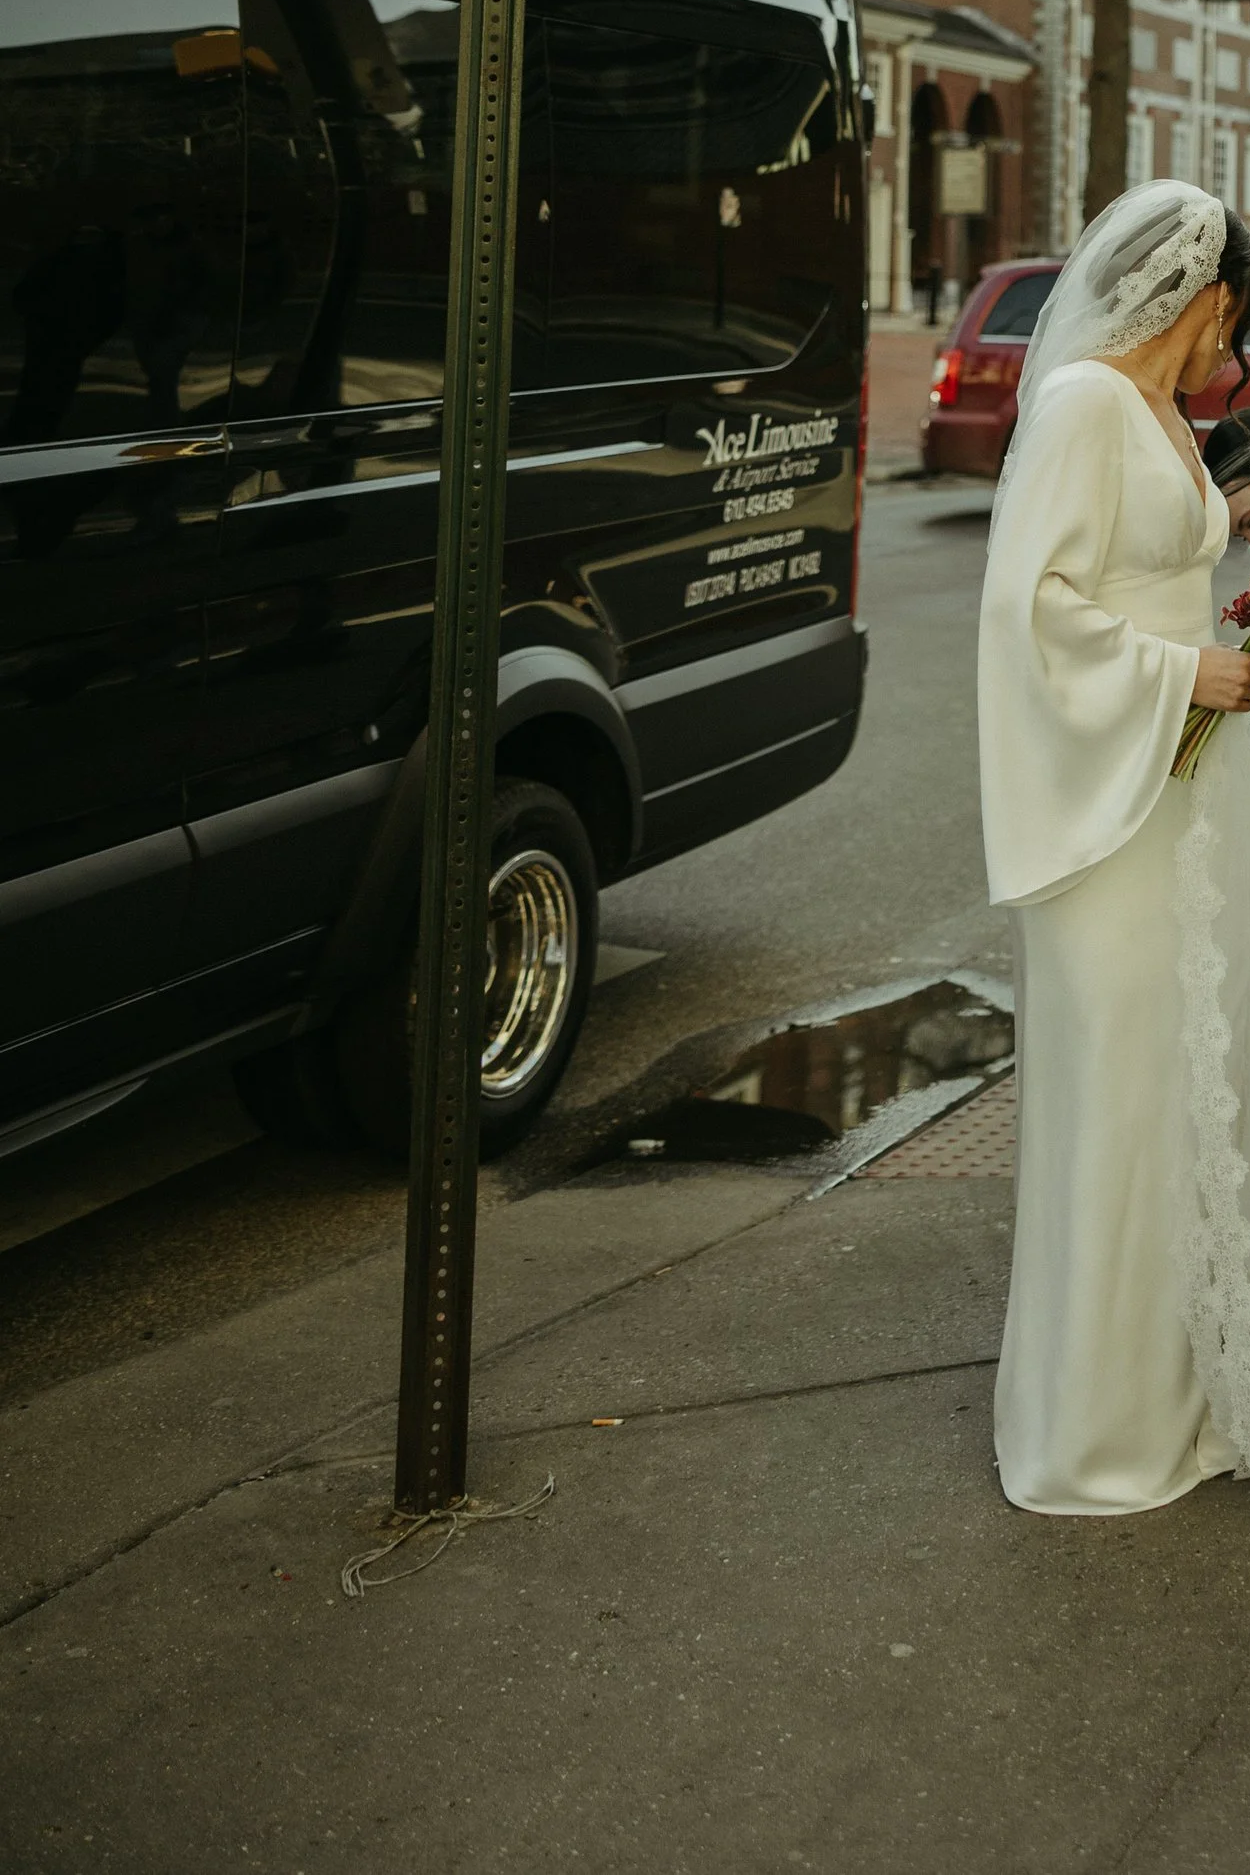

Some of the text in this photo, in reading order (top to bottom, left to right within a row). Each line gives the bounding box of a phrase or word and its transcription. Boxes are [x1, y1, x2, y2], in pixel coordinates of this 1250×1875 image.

[695, 408, 839, 466] Ace Limousine
[727, 465, 778, 492] Airport
[775, 453, 820, 481] Service
